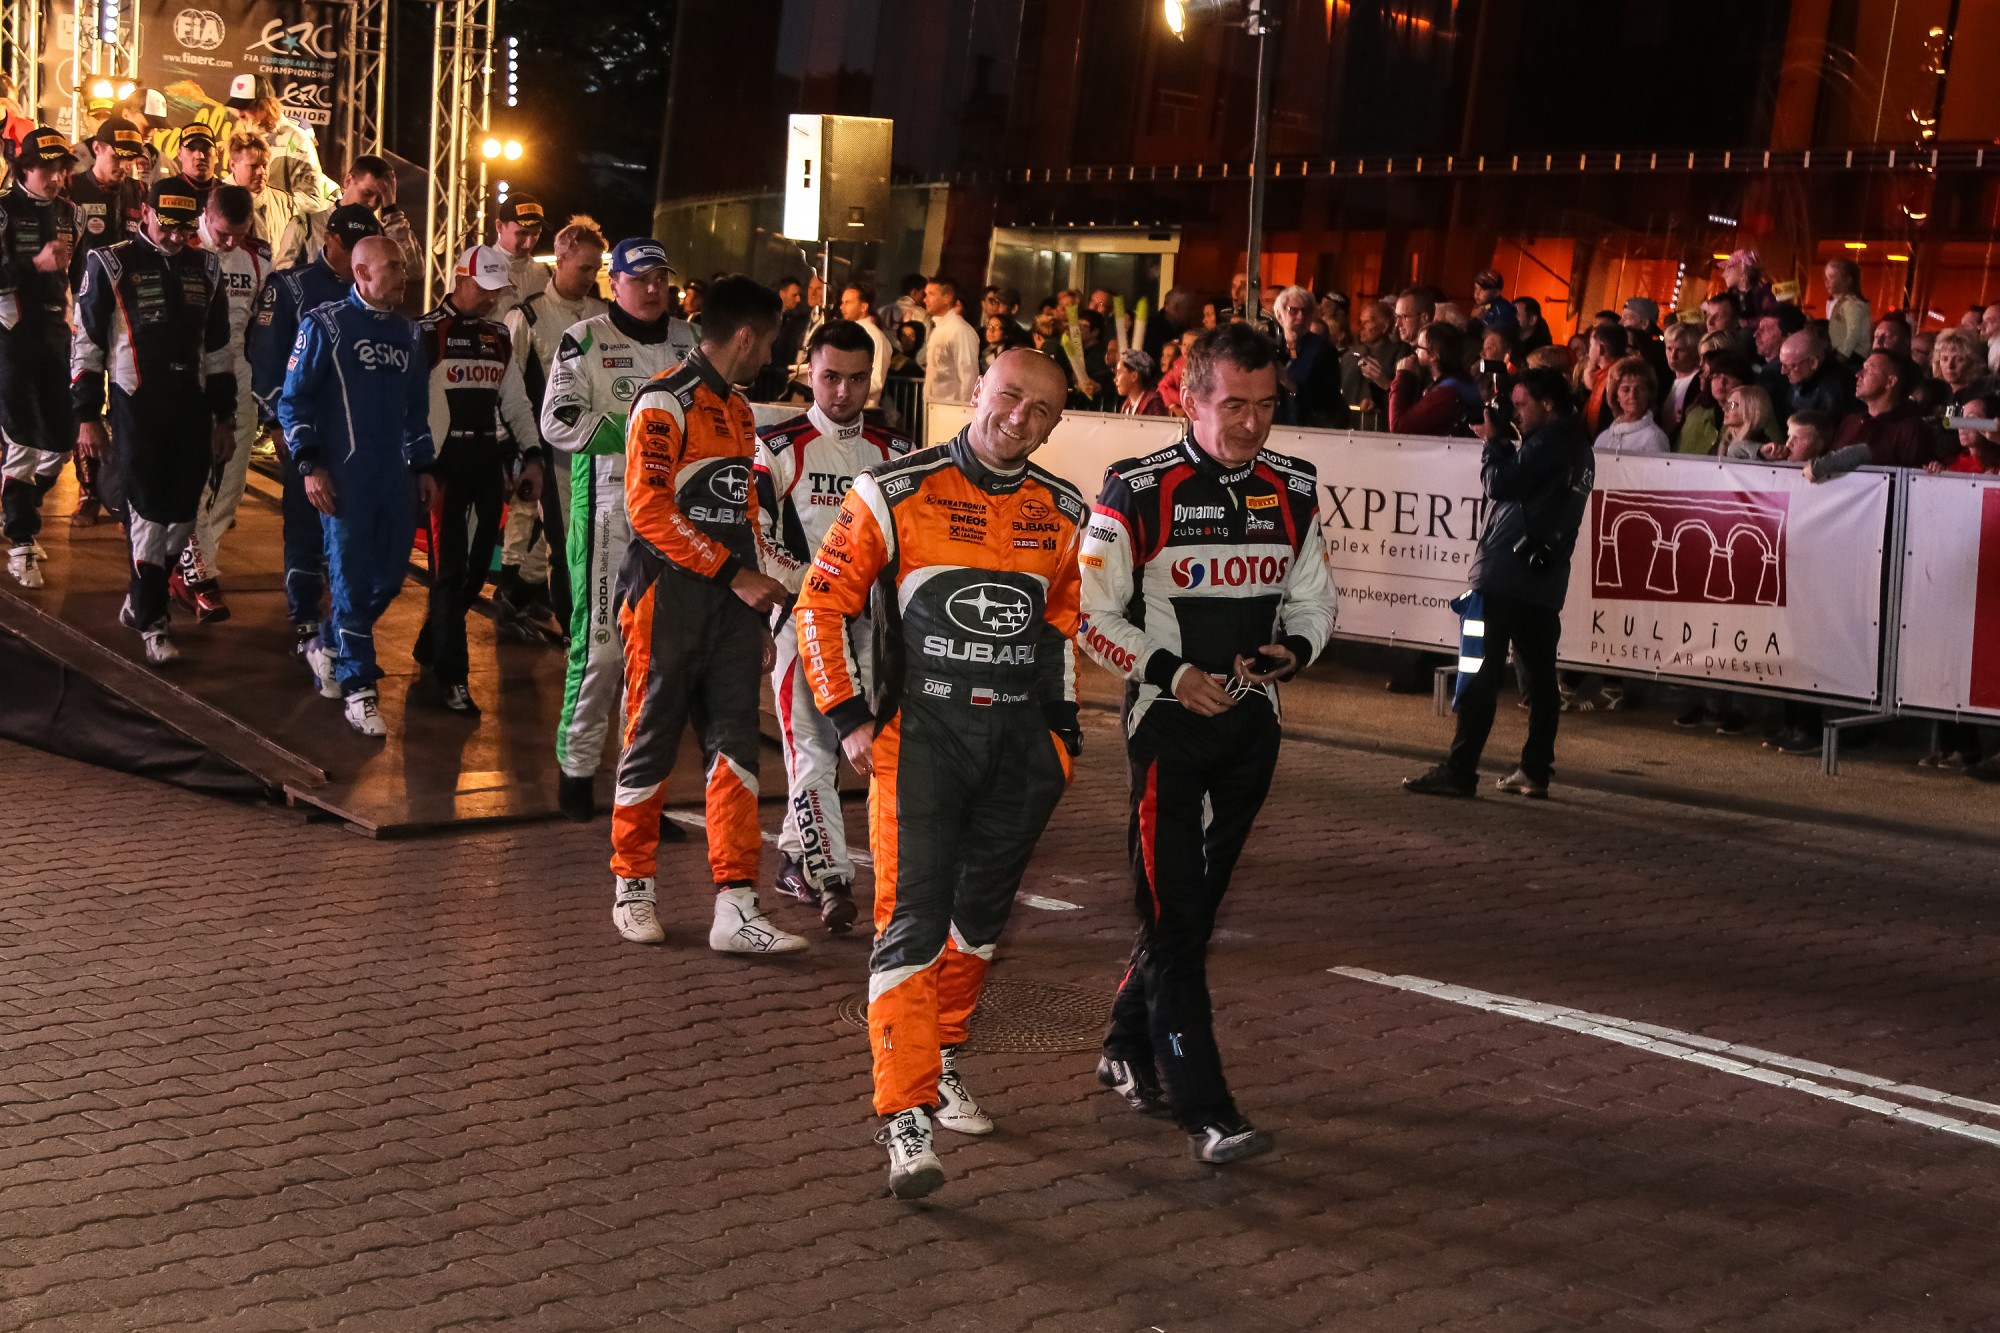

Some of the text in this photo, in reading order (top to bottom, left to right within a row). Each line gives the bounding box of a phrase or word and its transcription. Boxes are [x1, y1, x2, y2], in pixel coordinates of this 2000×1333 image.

[163, 52, 233, 68] www.fiaerc.com
[243, 53, 259, 63] FIA
[260, 56, 308, 67] EUROPEAN
[258, 64, 335, 79] CHAMPIONSHIP
[282, 108, 327, 122] UNIOR
[1151, 449, 1178, 463] LOTOS
[1266, 452, 1293, 467] LOTOS
[809, 472, 853, 496] TIG
[885, 478, 912, 495] OMP
[1130, 475, 1155, 490] OMP
[1288, 479, 1312, 494] OMP
[937, 498, 987, 511] KERATRONIK
[1060, 496, 1081, 514] OMP
[1321, 484, 1481, 541] XPERT
[951, 513, 987, 527] ENEOS
[1174, 503, 1225, 523] Dynamic
[1012, 521, 1060, 532] SUBARU
[1210, 555, 1290, 587] LOTOS
[1592, 609, 1780, 656] KULDĪGA
[923, 635, 1036, 665] SUBARU
[1086, 625, 1137, 673] LOTOS
[1673, 651, 1694, 667] AR
[923, 682, 952, 696] OMP
[993, 692, 1001, 701] D.
[793, 790, 828, 879] TIGER
[808, 787, 837, 868] ENERGY DRINK
